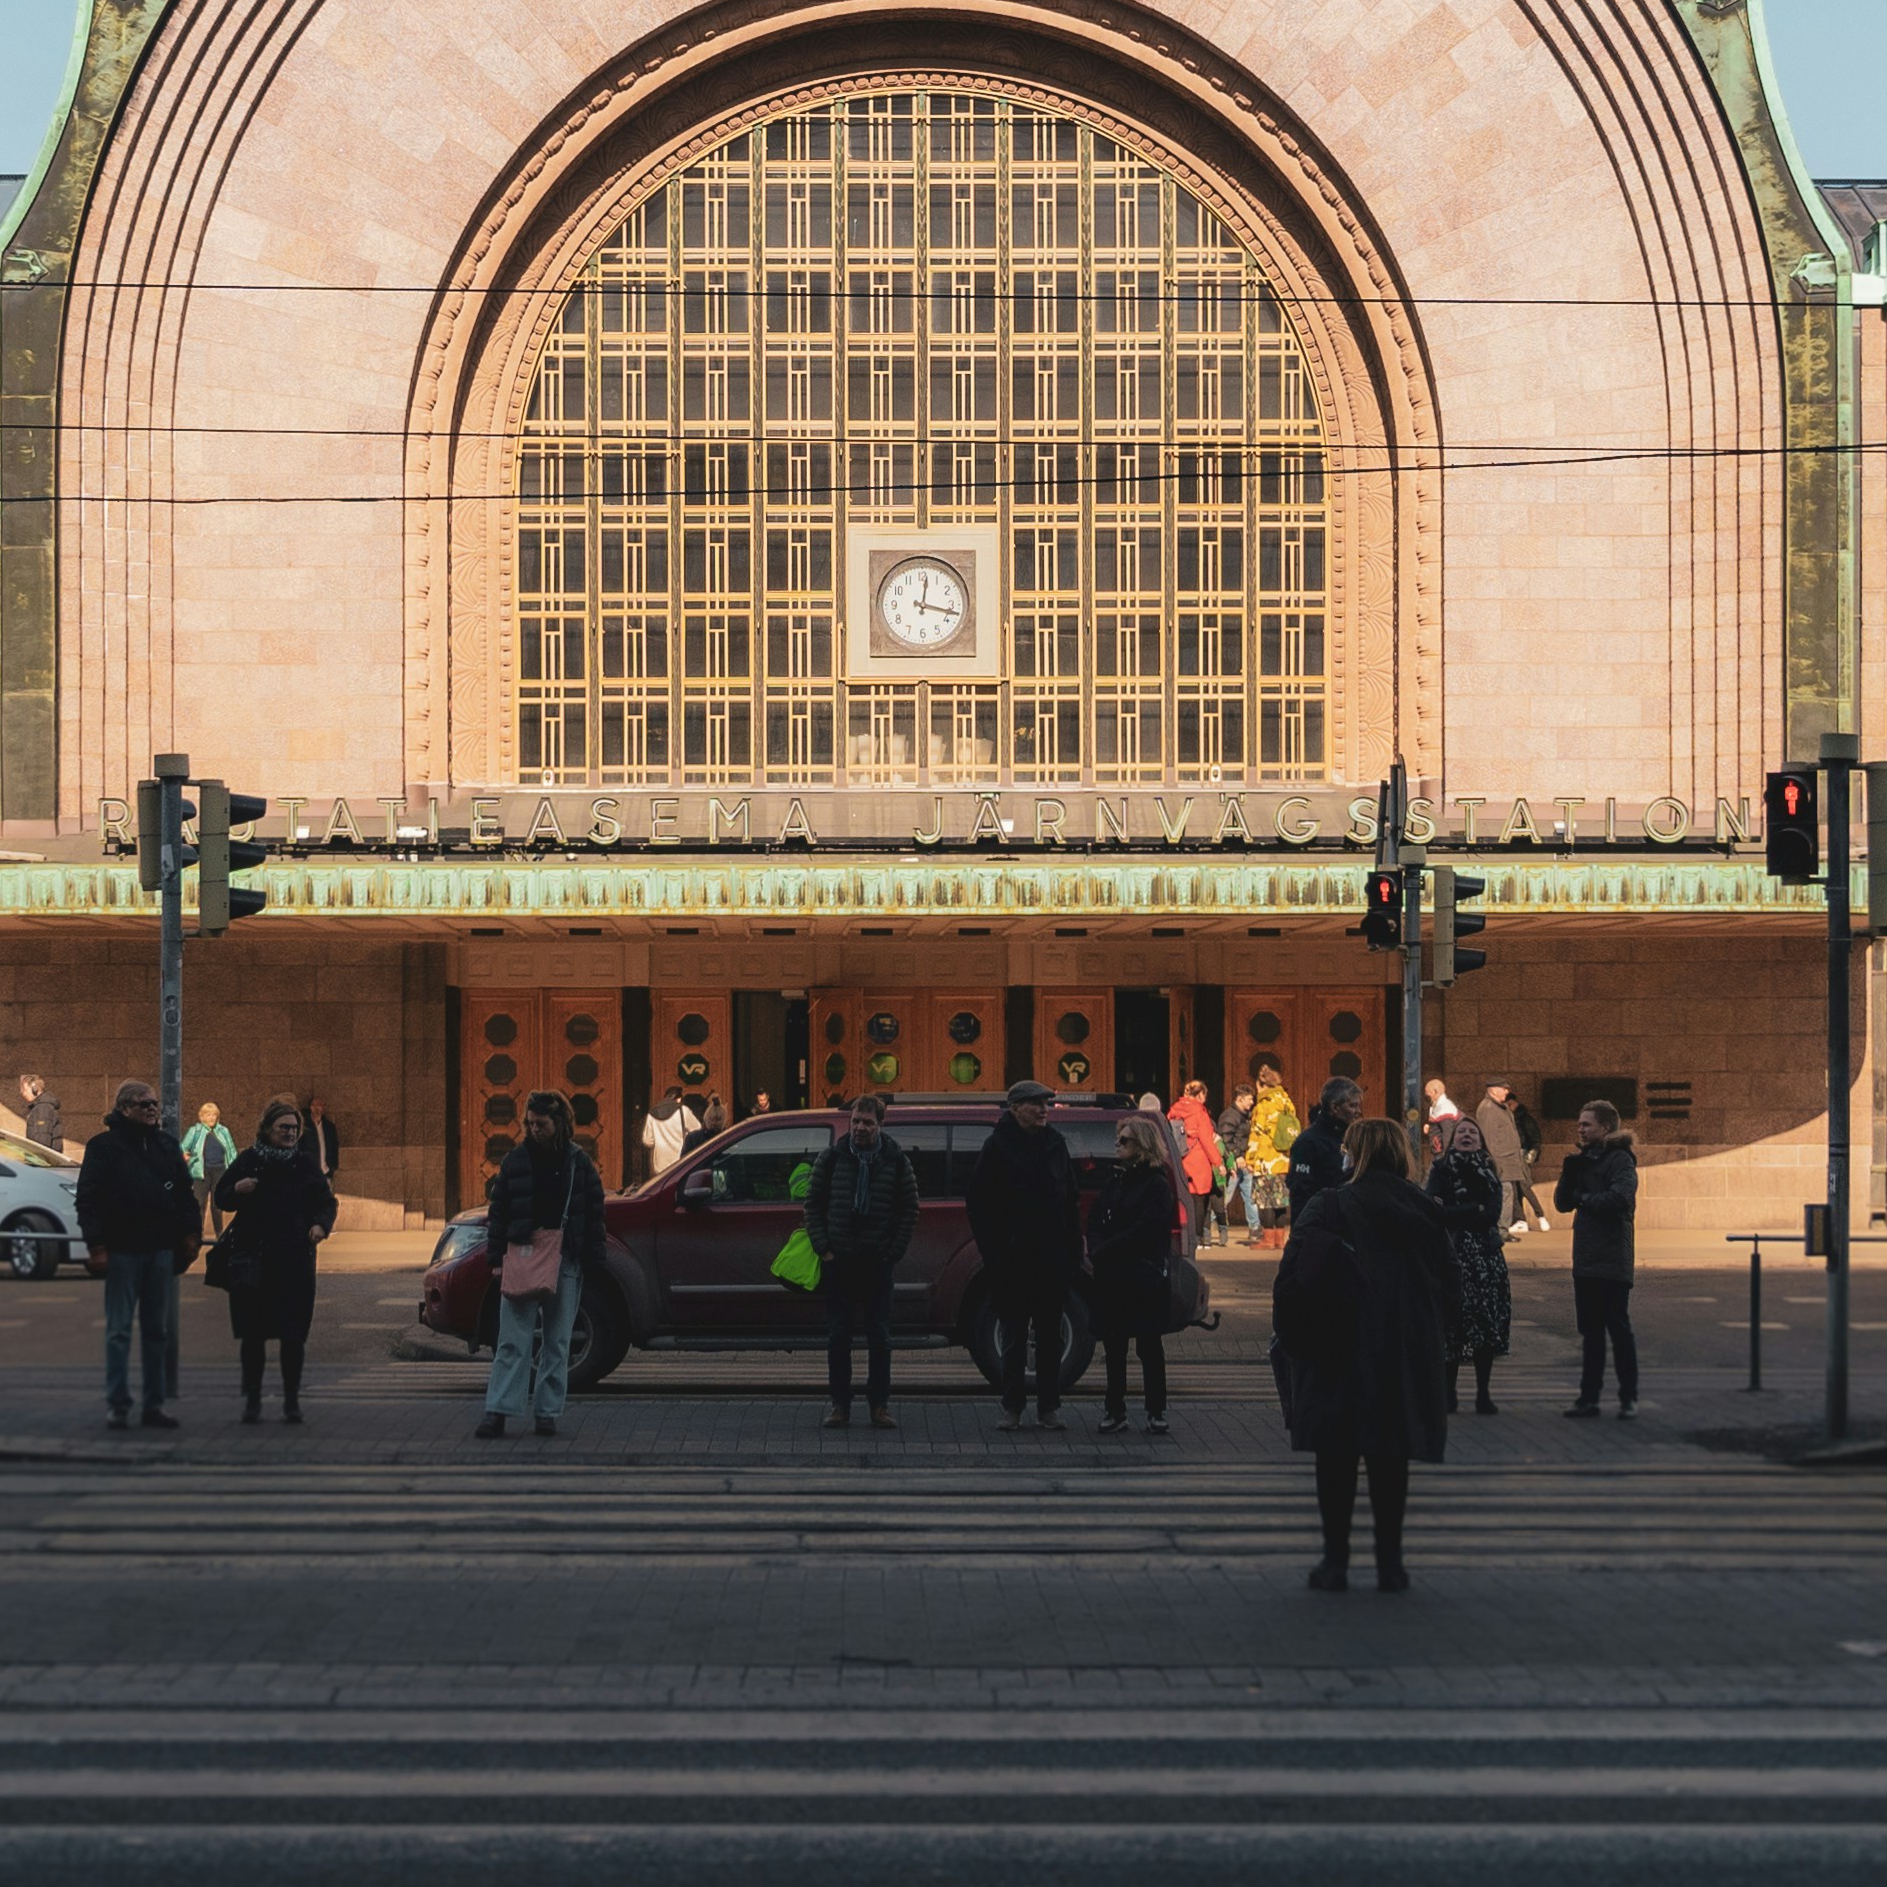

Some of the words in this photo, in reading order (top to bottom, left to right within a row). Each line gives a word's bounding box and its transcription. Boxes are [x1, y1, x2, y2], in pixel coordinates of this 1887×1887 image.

[905, 575, 911, 585] 11
[894, 585, 903, 596] 10
[944, 585, 950, 596] 2
[891, 600, 897, 610] 9
[948, 600, 954, 610] 3
[895, 614, 901, 624] 8
[905, 625, 911, 635] 7
[919, 628, 926, 638] 6
[934, 625, 940, 635] 5
[914, 793, 1751, 845] JÄRNVÄGSSTATION
[681, 1063, 706, 1075] VR
[1062, 1061, 1086, 1073] VR
